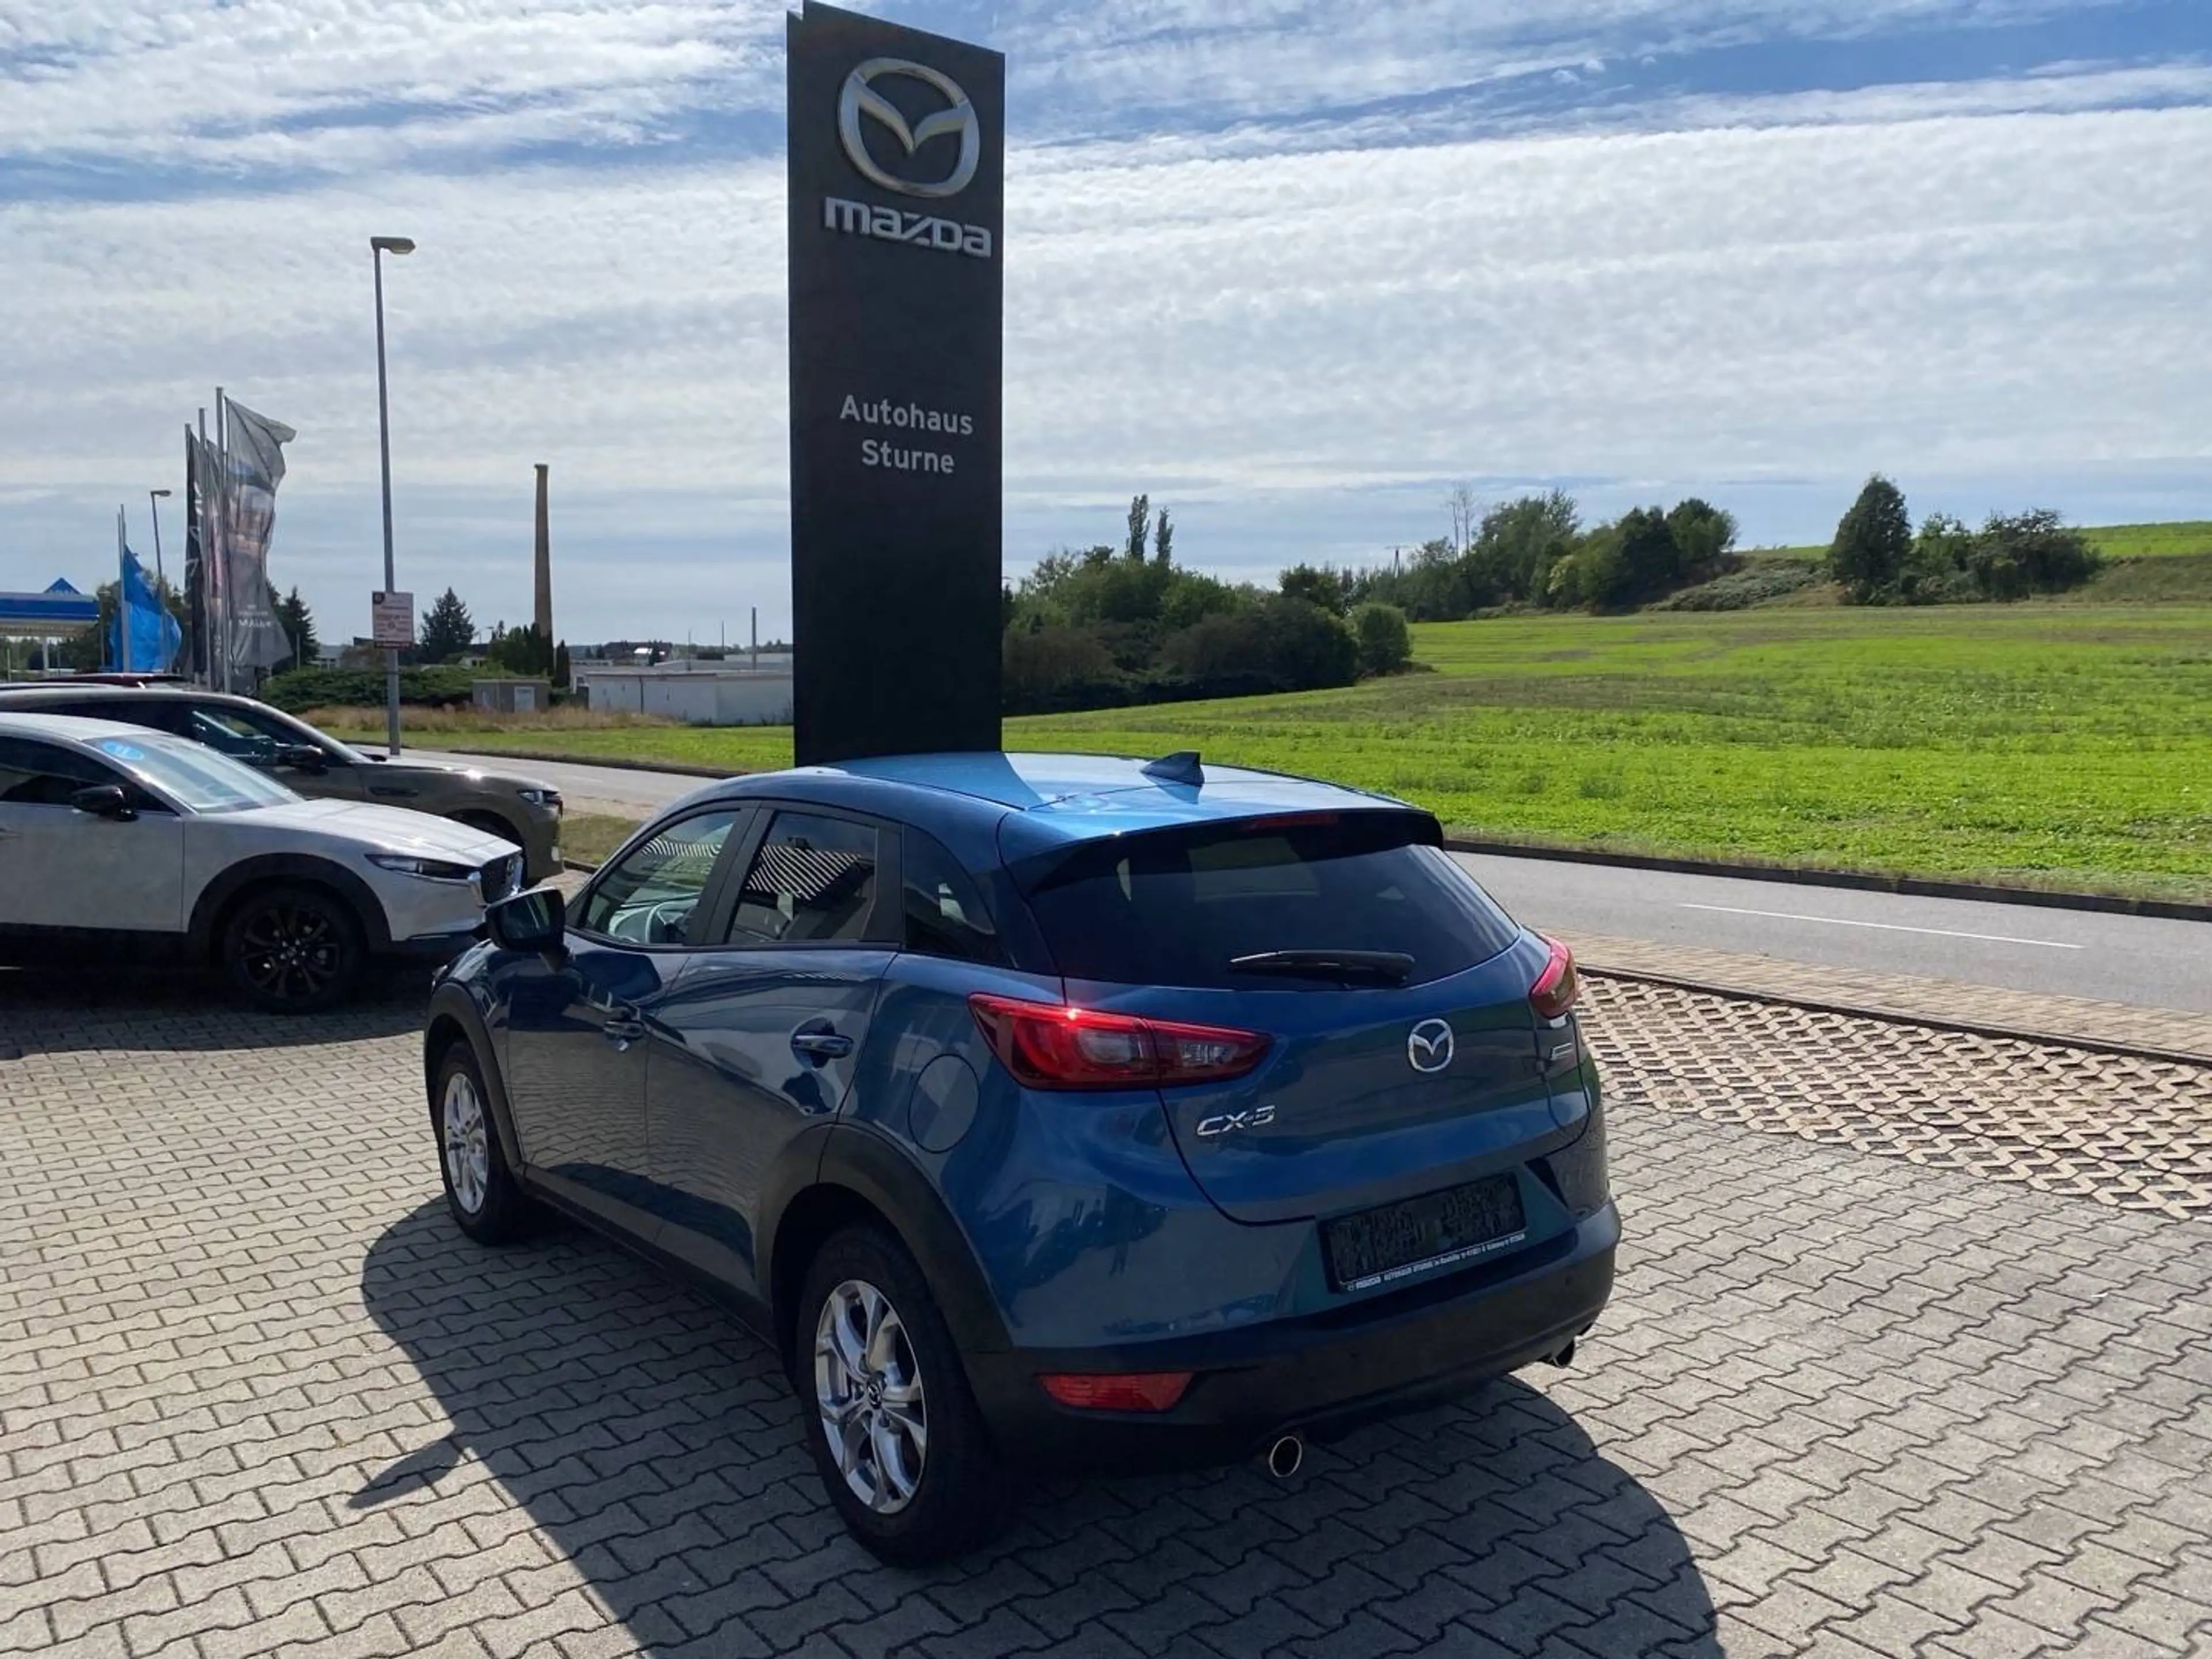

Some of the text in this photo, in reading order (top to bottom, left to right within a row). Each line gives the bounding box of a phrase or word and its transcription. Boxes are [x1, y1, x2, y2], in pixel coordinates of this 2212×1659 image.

[840, 395, 973, 435] Autohaus
[862, 439, 955, 474] Sturne
[1197, 1105, 1275, 1136] CX-3
